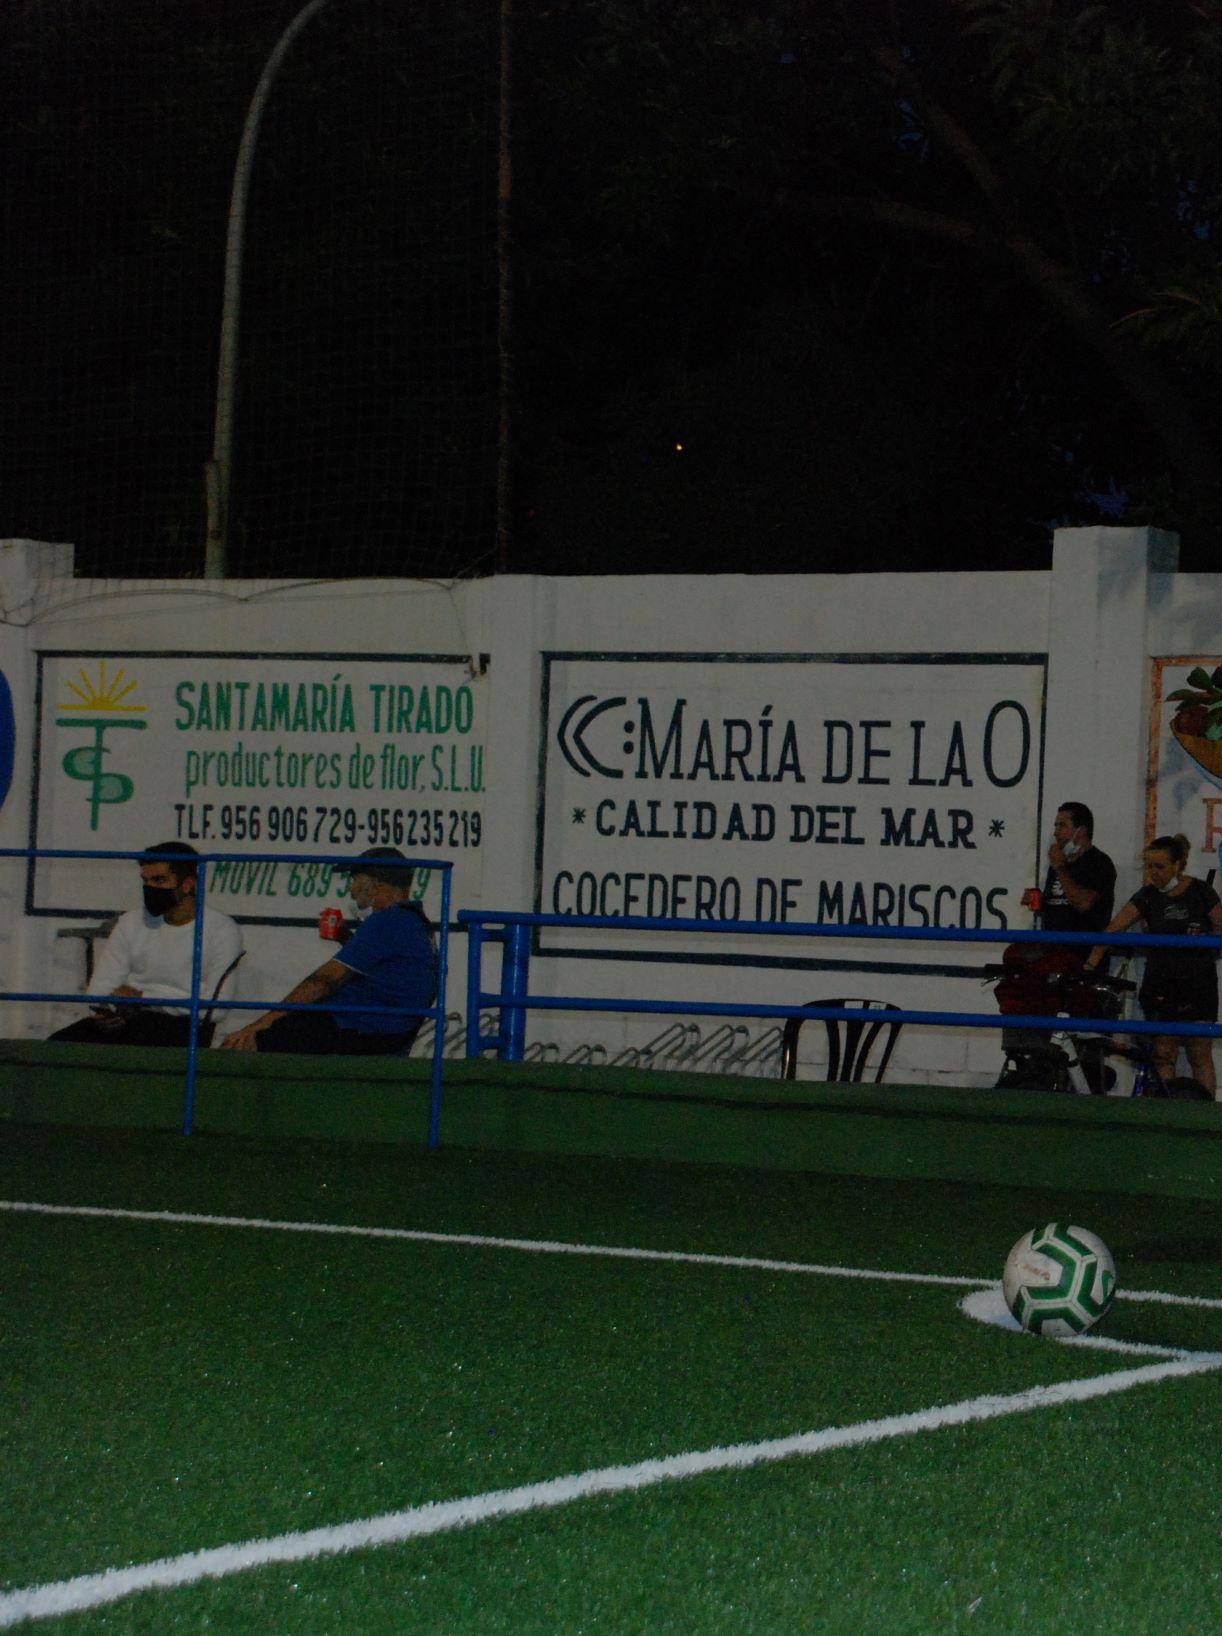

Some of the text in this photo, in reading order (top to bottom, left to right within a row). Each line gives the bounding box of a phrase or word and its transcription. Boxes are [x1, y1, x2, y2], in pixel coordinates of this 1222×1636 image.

[175, 673, 474, 734] SANTAMARÍA TIRADO
[186, 742, 342, 798] productores
[349, 742, 374, 790] de
[635, 696, 1031, 788] MARÍA DE LA O
[268, 805, 308, 842] 906
[595, 800, 977, 849] CALIDAD DEL MAR
[553, 871, 742, 921] COCEDERO
[756, 877, 802, 924] DE
[817, 880, 1008, 931] MARISCOS
